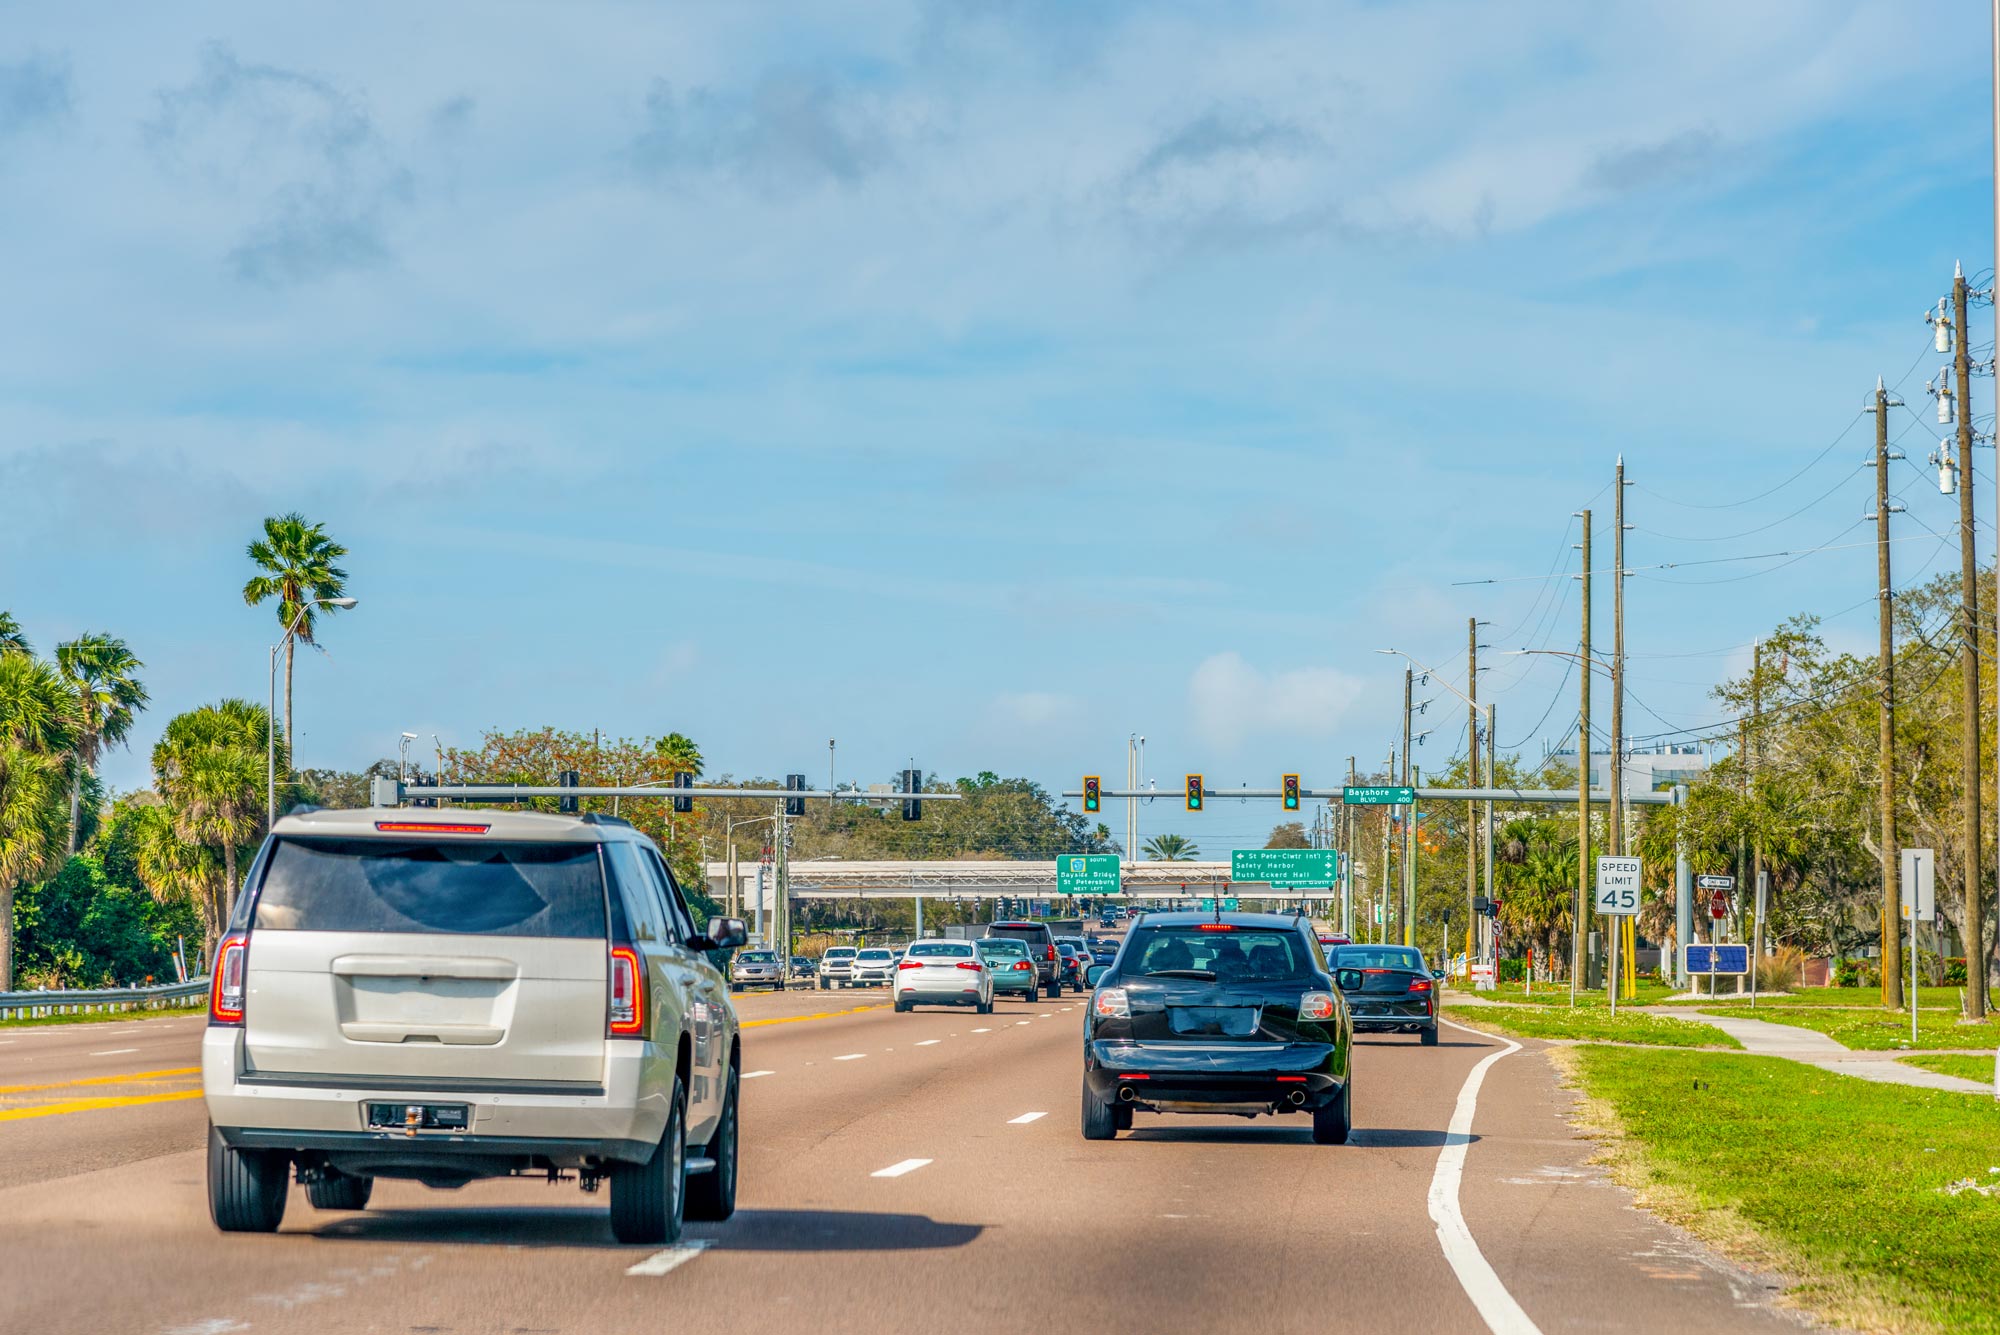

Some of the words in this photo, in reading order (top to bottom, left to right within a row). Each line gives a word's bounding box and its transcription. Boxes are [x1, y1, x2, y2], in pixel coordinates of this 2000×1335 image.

[1601, 863, 1637, 872] SPEED
[1605, 877, 1632, 885] LIMIT
[1601, 890, 1635, 908] 45
[1712, 898, 1725, 910] STOP
